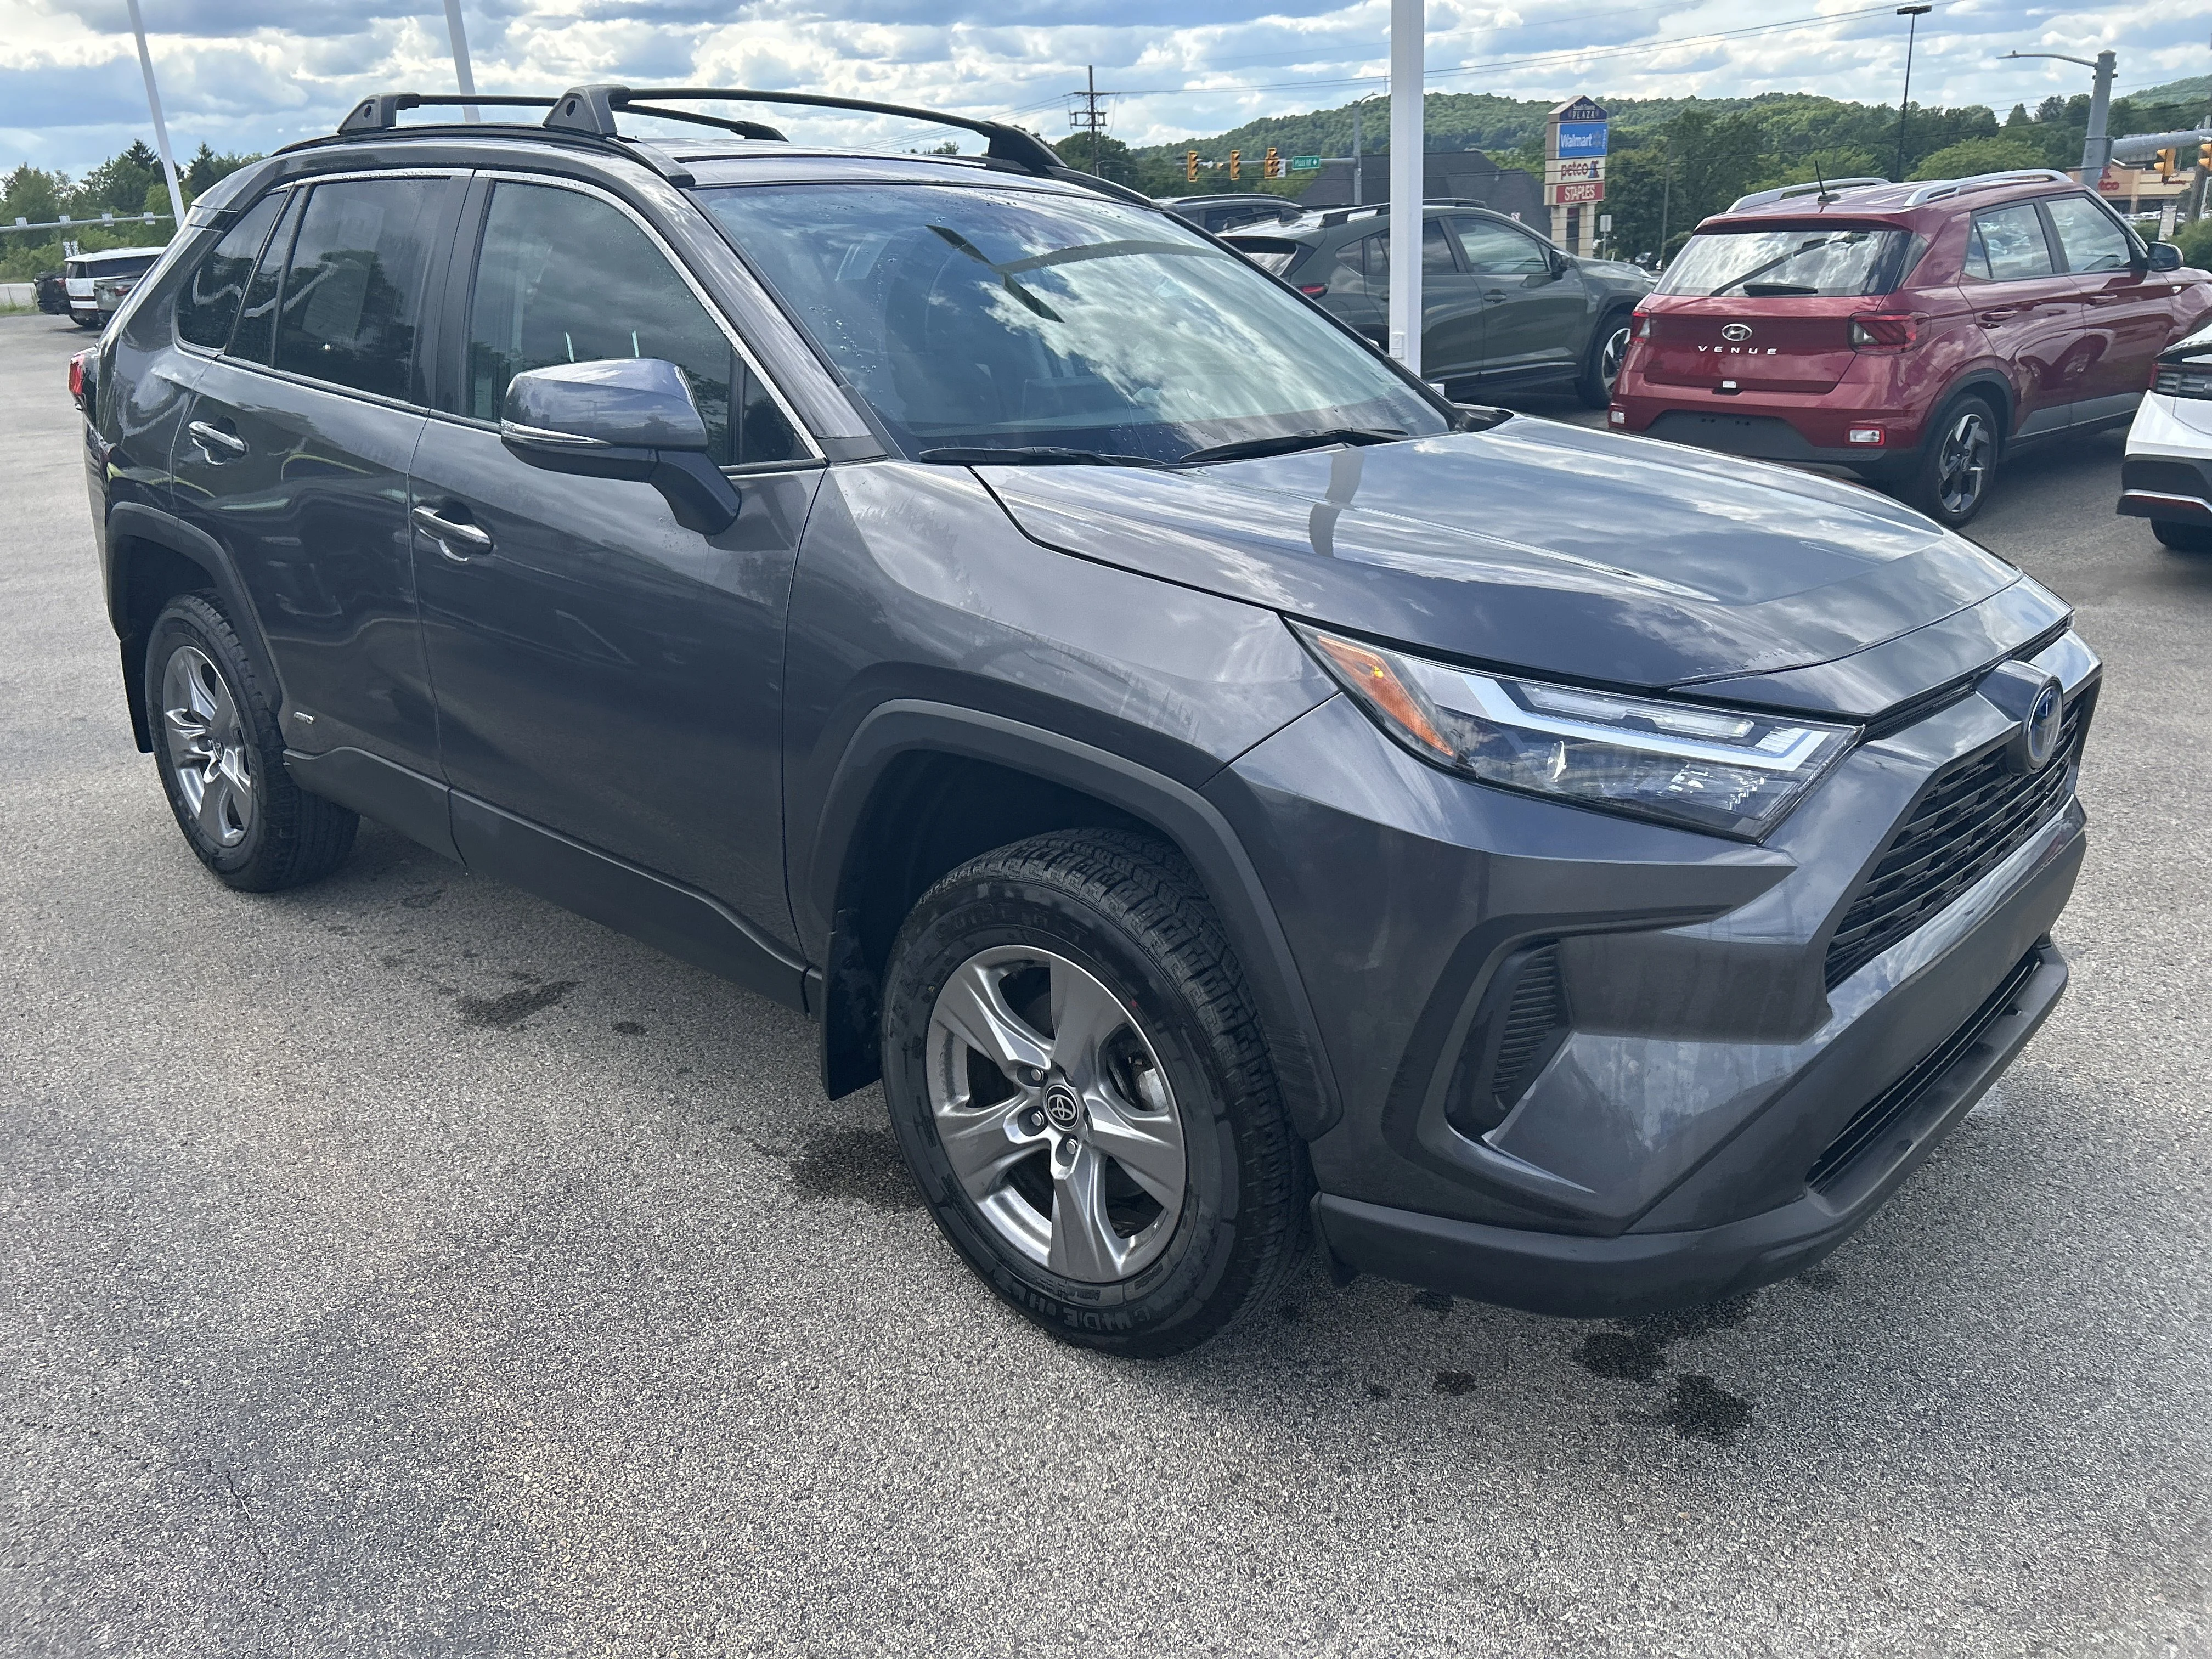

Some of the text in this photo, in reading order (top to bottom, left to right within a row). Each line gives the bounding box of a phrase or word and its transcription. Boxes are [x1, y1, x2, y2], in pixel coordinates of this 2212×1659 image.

[1572, 111, 1595, 119] PLAZA
[1561, 133, 1592, 148] Walmart
[1561, 161, 1588, 180] petco
[1565, 185, 1595, 201] STAPLES
[1699, 346, 1778, 355] VENUE
